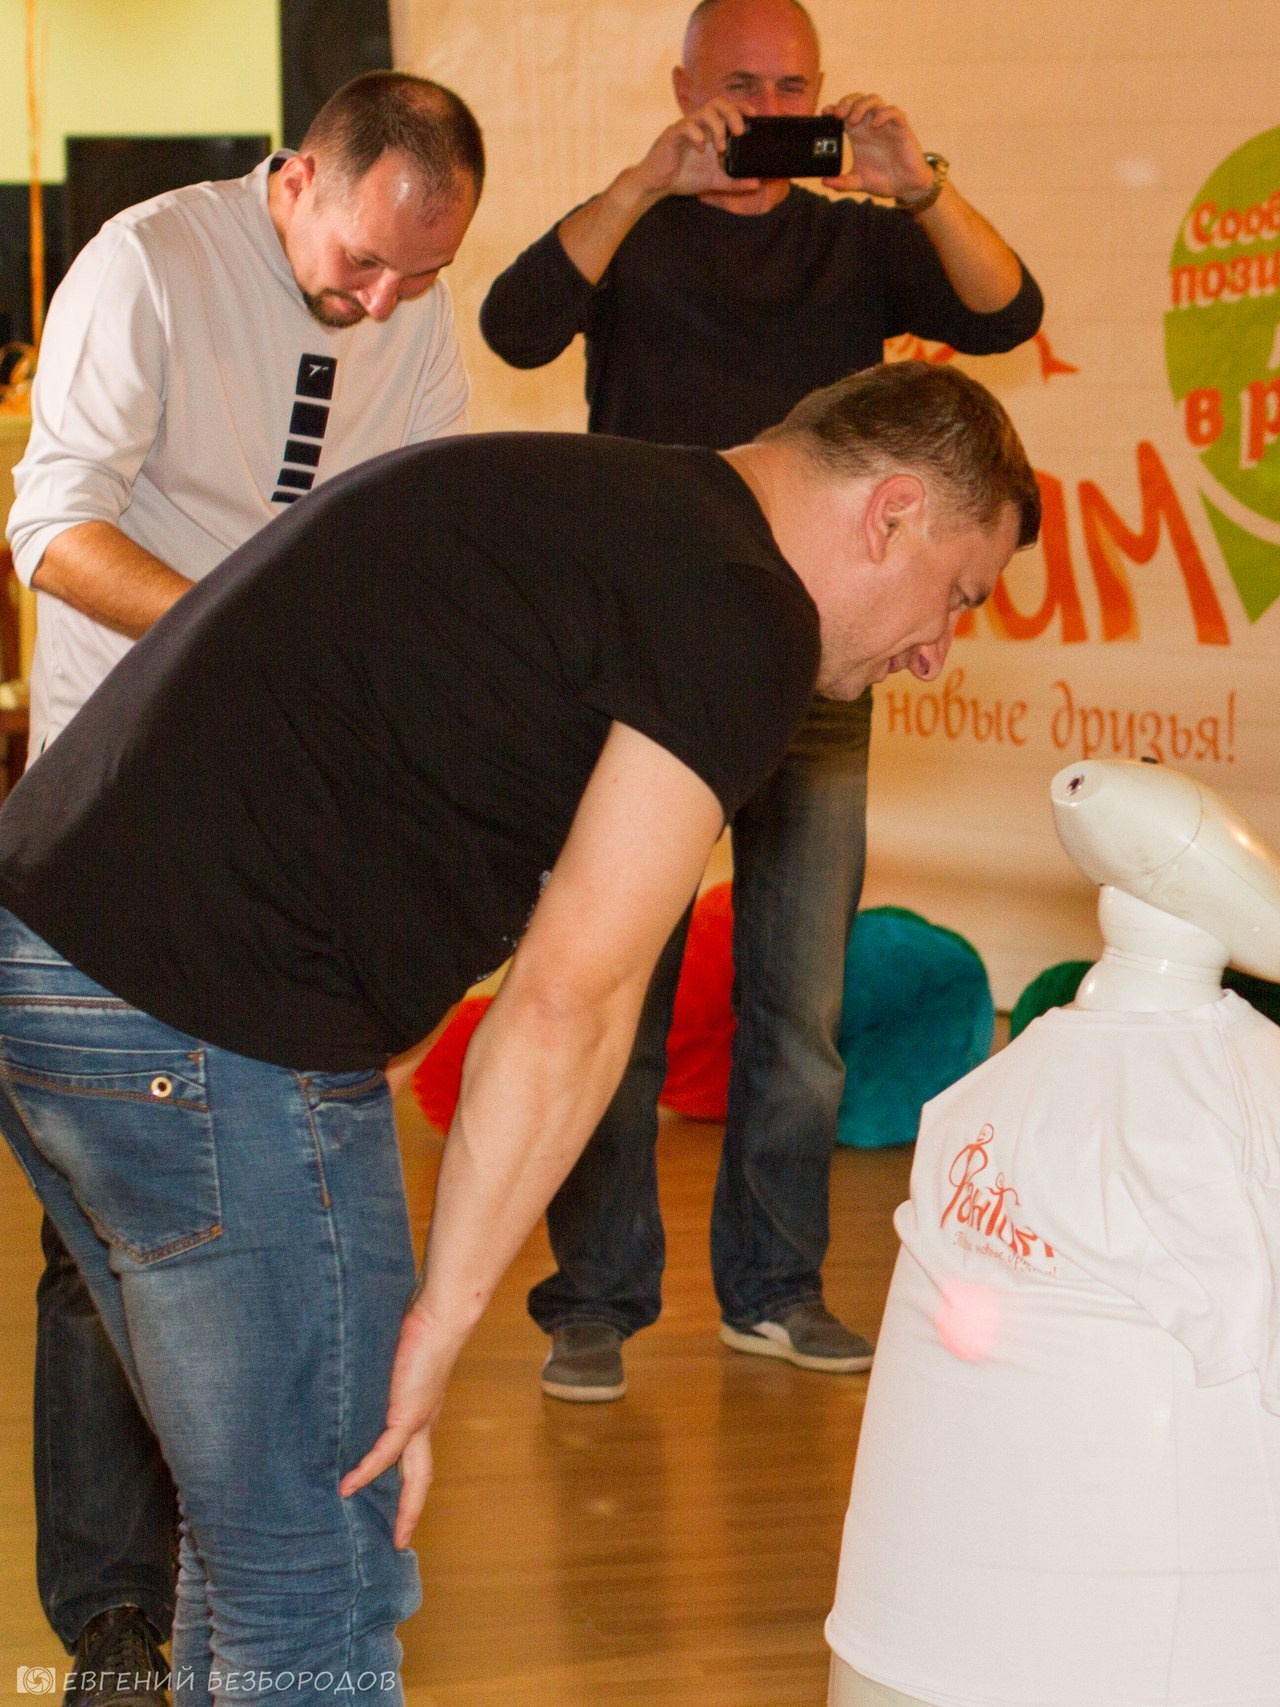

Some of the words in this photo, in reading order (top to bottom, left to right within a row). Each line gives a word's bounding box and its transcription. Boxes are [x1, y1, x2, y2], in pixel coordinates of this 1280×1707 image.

[1185, 390, 1226, 450] в
[885, 667, 1029, 747] новые
[1051, 679, 1238, 765] друзья!
